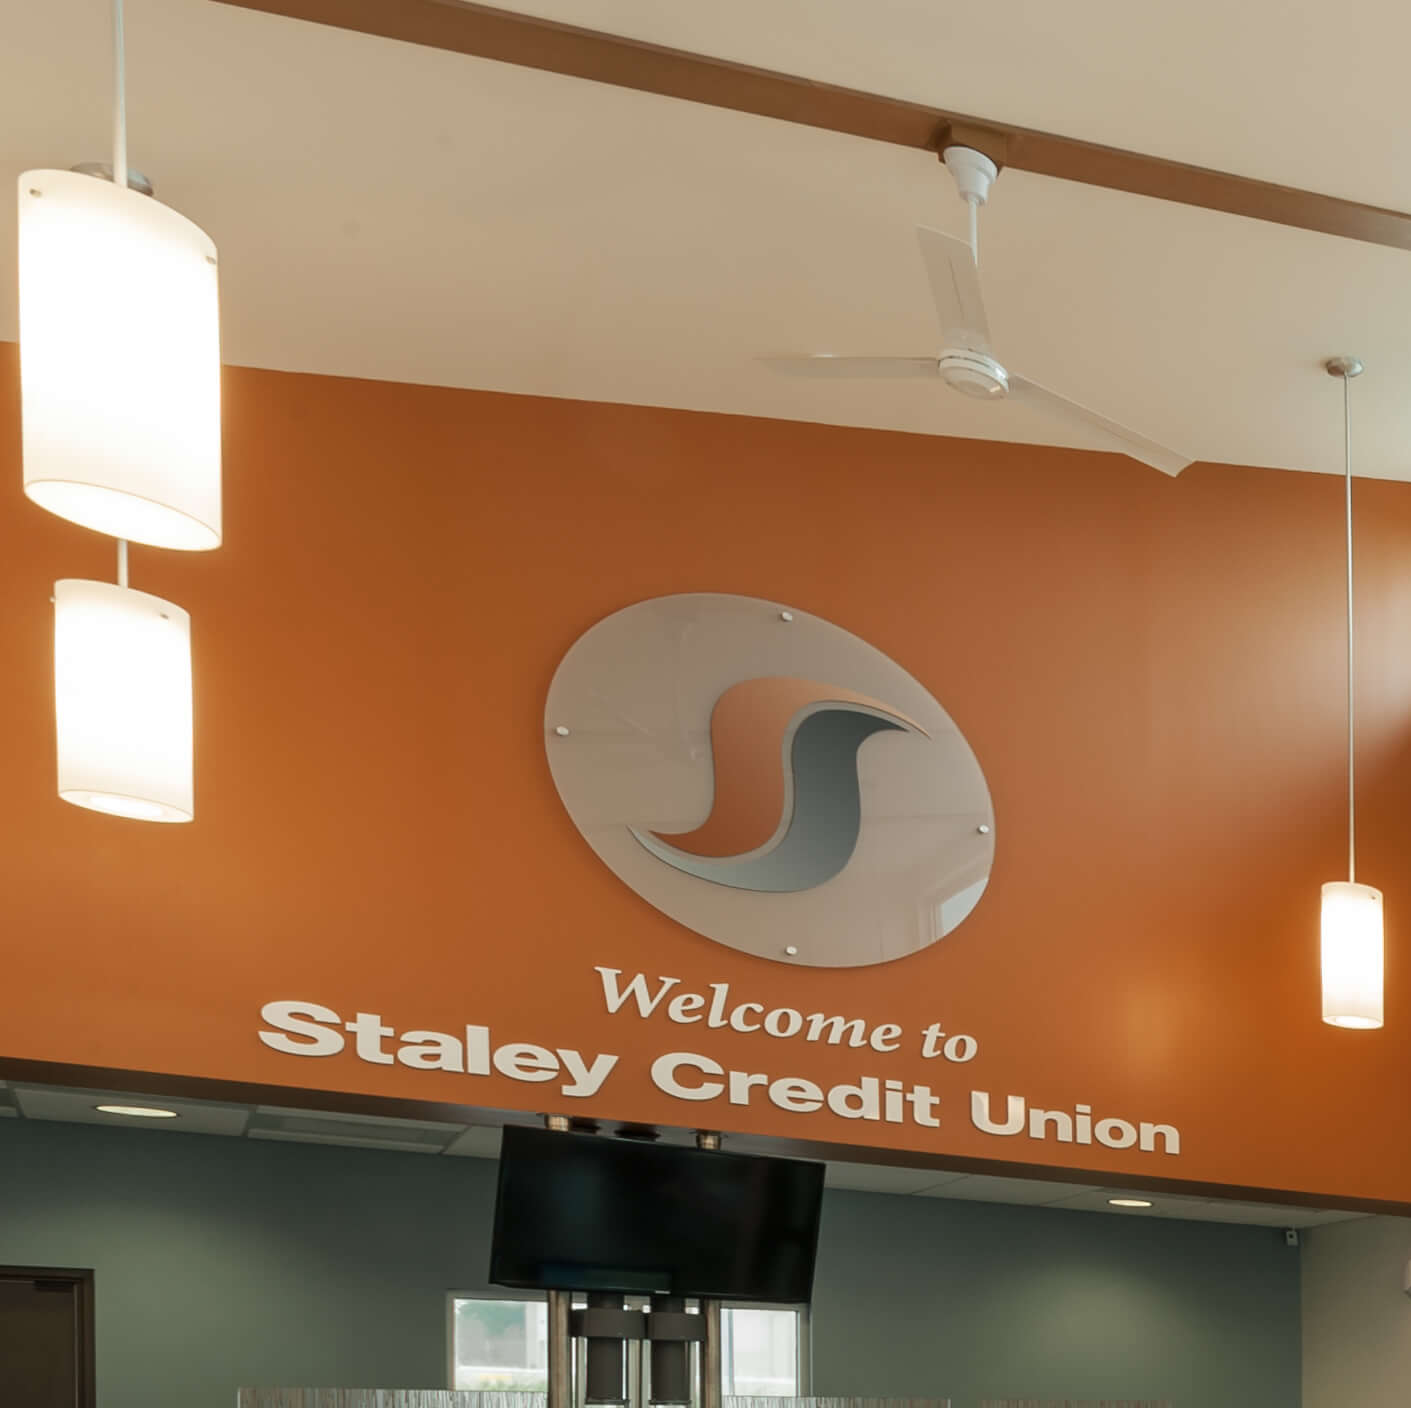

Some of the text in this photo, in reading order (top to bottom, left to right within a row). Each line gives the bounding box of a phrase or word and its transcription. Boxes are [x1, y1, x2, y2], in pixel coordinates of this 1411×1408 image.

[256, 999, 1182, 1155] Staley Credit Union
[593, 965, 979, 1063] Welcome to
